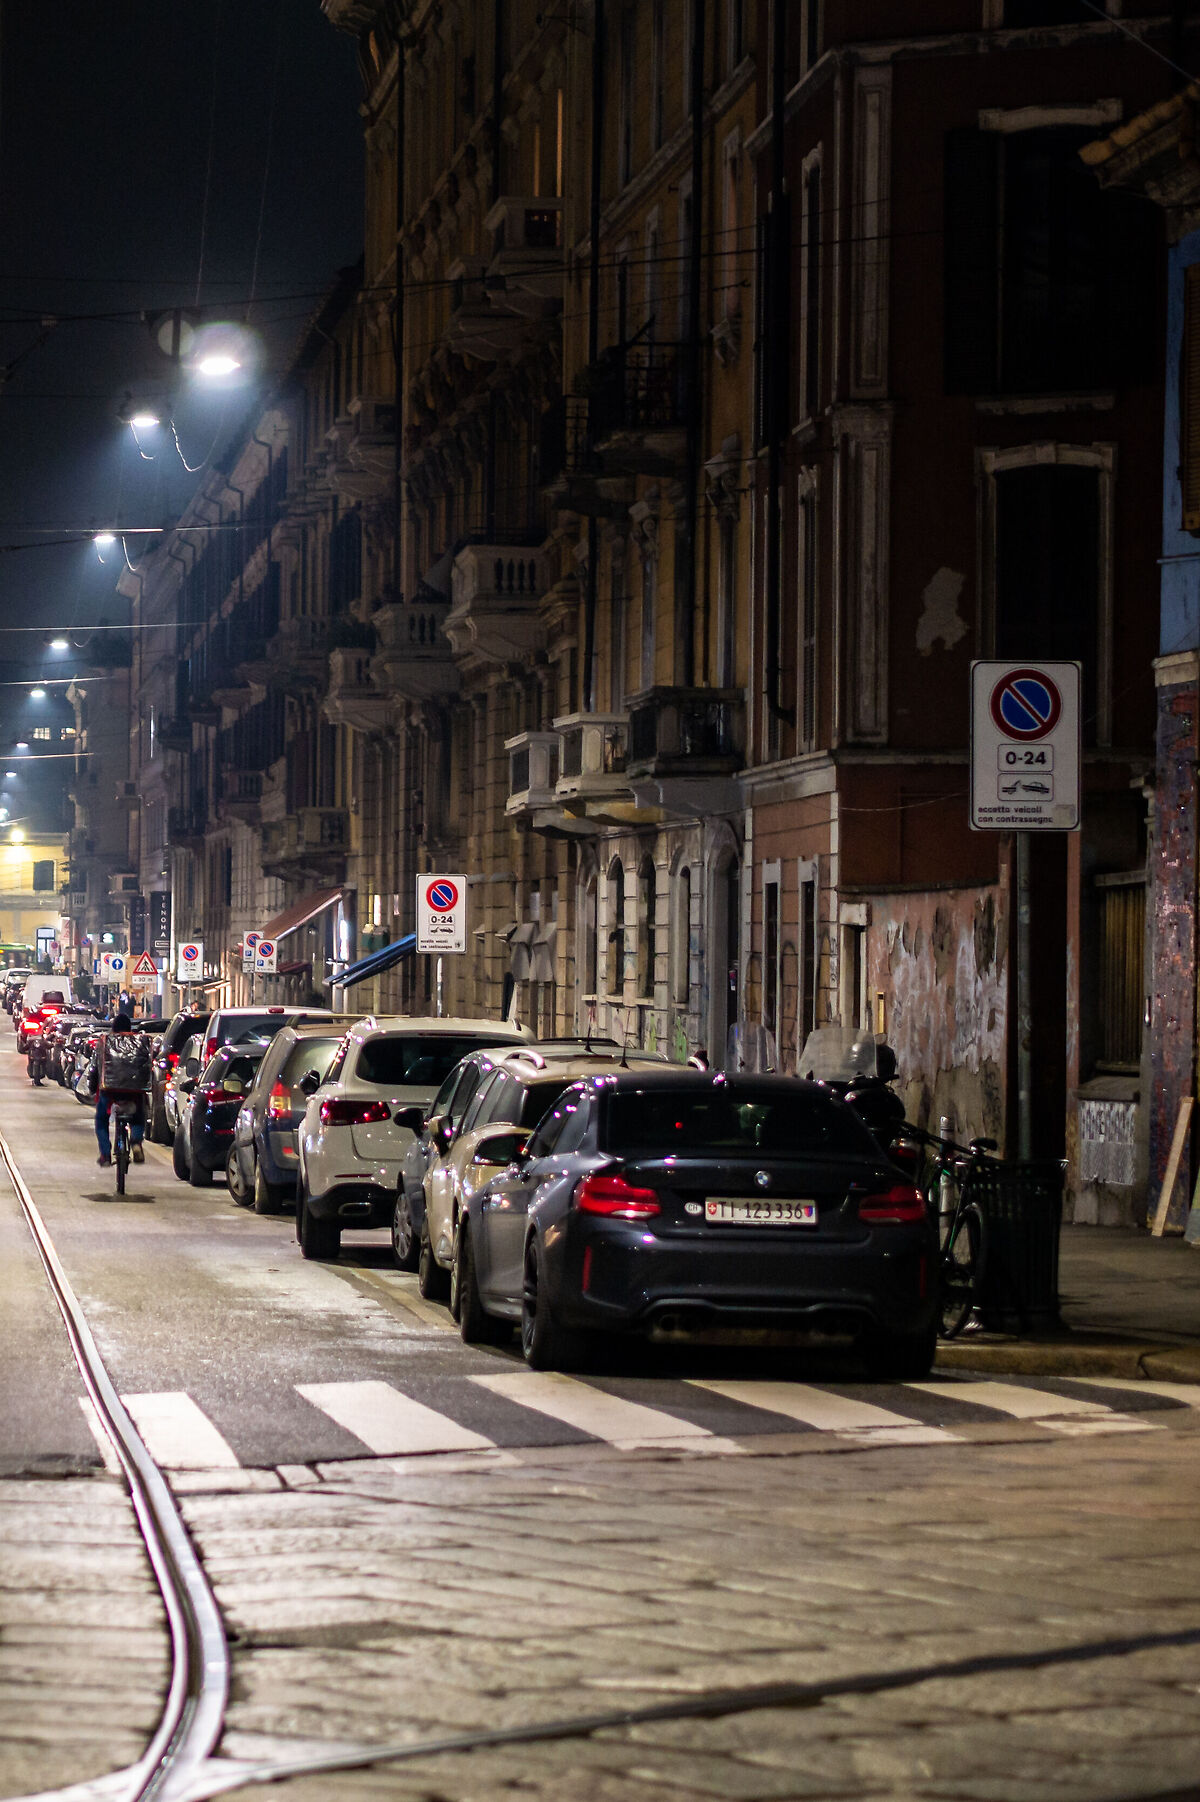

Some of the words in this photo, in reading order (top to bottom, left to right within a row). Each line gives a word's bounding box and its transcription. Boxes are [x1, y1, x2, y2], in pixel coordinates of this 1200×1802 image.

[1005, 751, 1047, 765] 0-24
[978, 805, 1011, 814] eccetto
[1014, 805, 1043, 814] veicoli
[430, 915, 453, 924] 0-24
